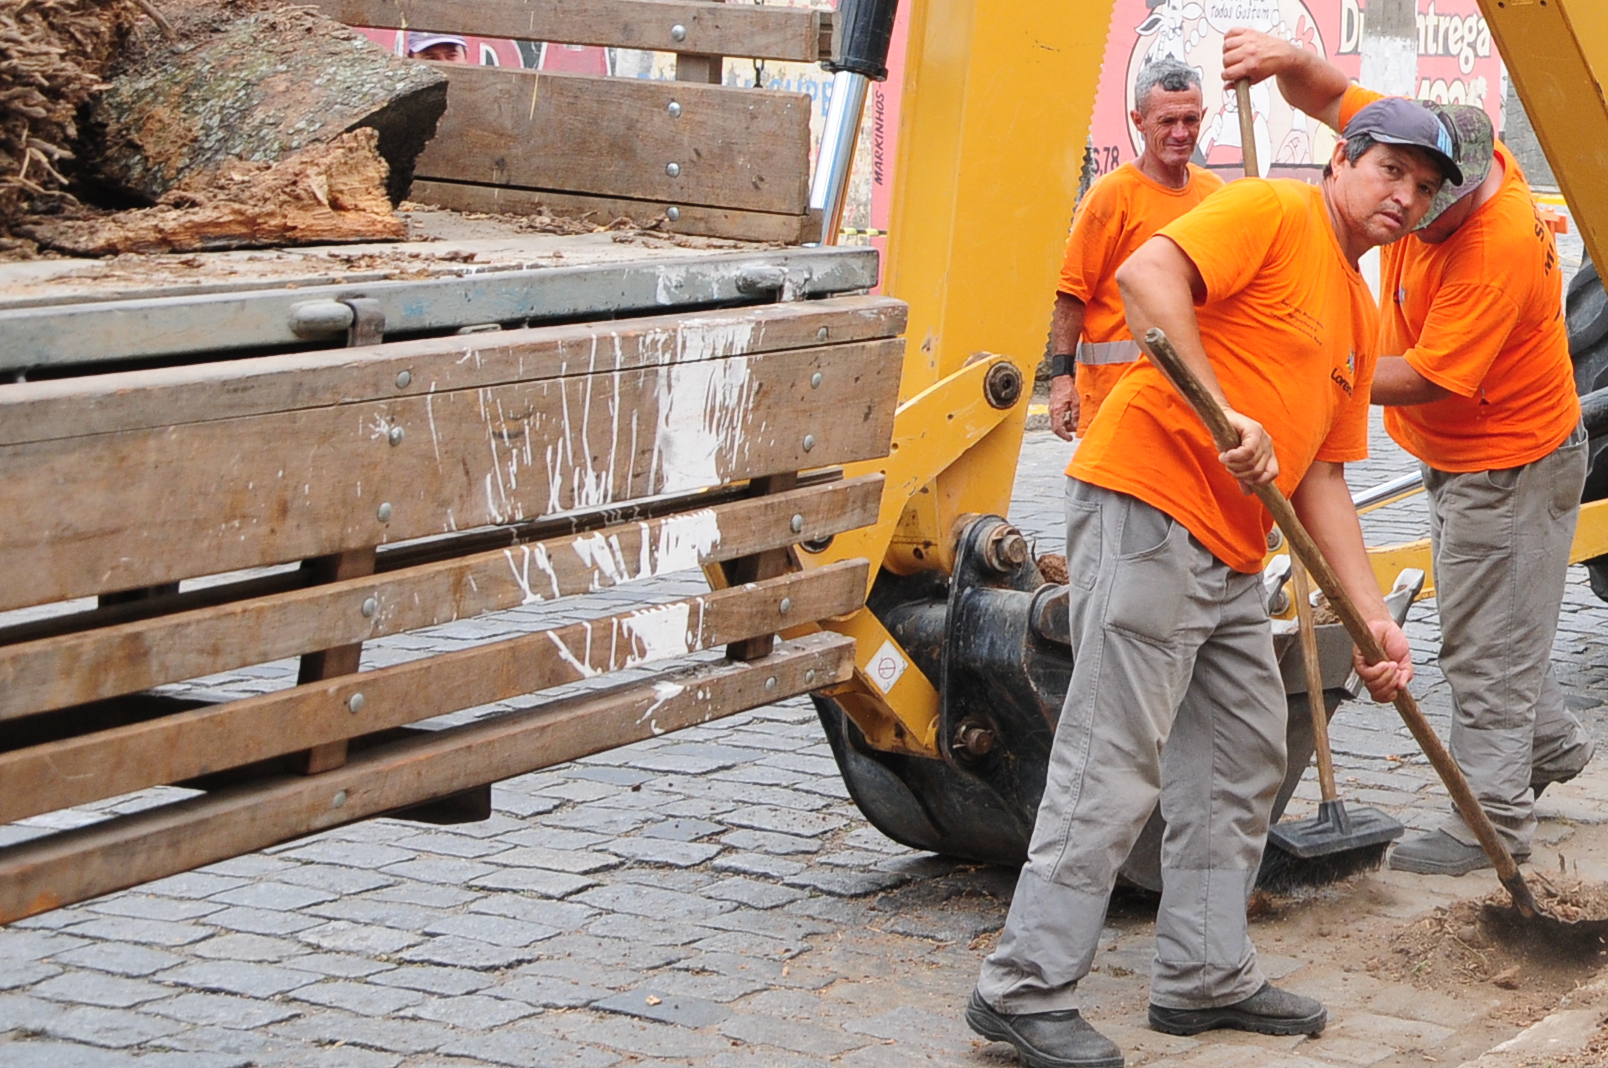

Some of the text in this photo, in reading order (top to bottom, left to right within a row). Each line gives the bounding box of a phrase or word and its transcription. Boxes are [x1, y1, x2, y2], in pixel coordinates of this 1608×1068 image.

[1210, 3, 1270, 20] Todos Gostam
[874, 89, 885, 186] MARKINHOS
